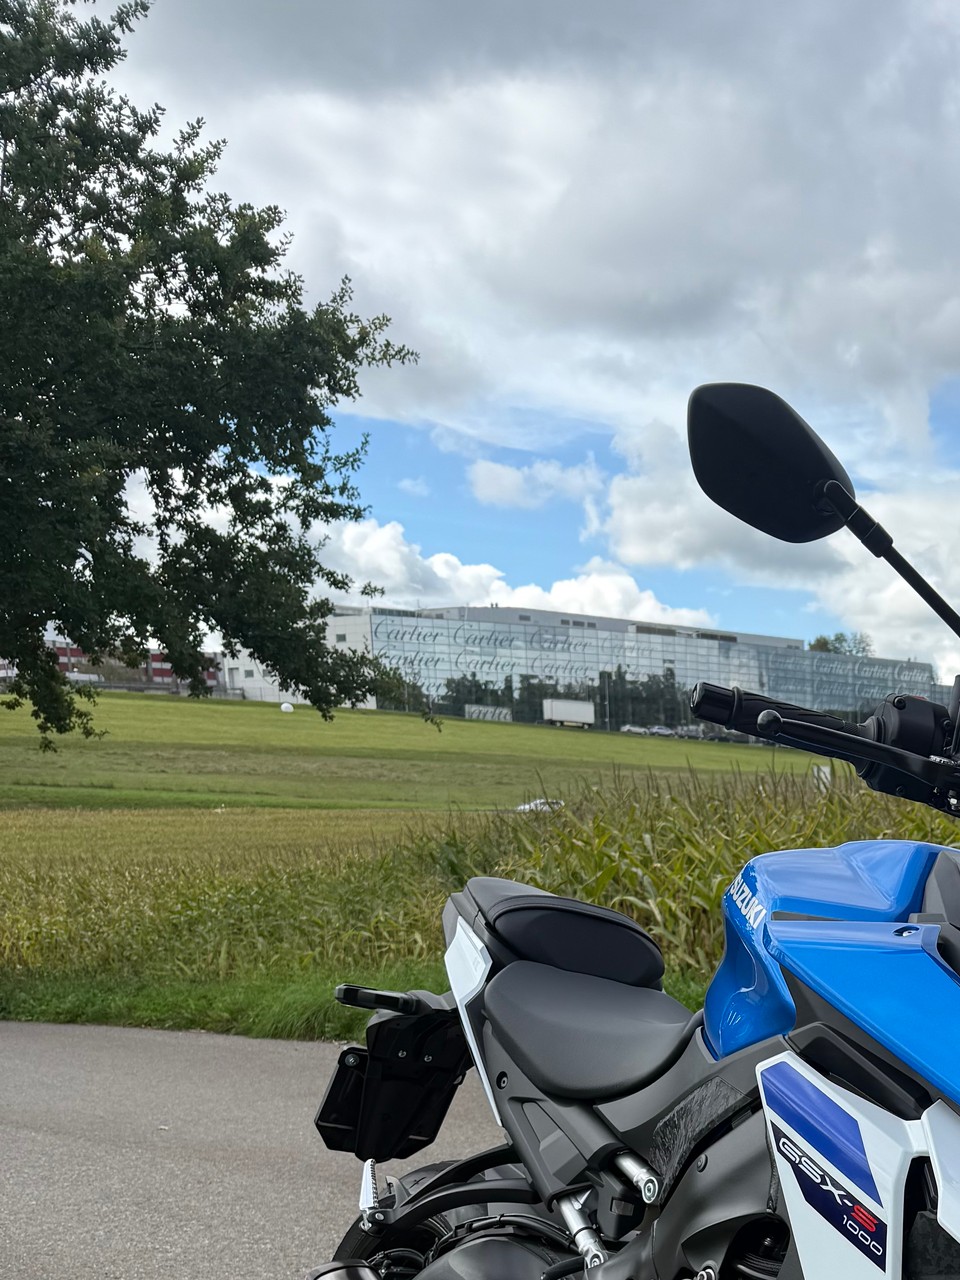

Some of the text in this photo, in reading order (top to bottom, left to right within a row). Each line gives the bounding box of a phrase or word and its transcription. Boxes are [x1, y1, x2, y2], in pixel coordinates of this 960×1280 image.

[374, 618, 443, 643] Cartier
[453, 623, 519, 648] Cartier
[530, 629, 592, 652] Cartier
[456, 649, 520, 672] Cartier
[532, 654, 593, 676] Cartier
[813, 655, 850, 675] Cartier
[854, 659, 891, 679] Cartier
[894, 663, 931, 682] Cartier
[729, 874, 767, 930] SUZUKI
[779, 1137, 878, 1232] GSX-S
[843, 1214, 882, 1256] 1000
